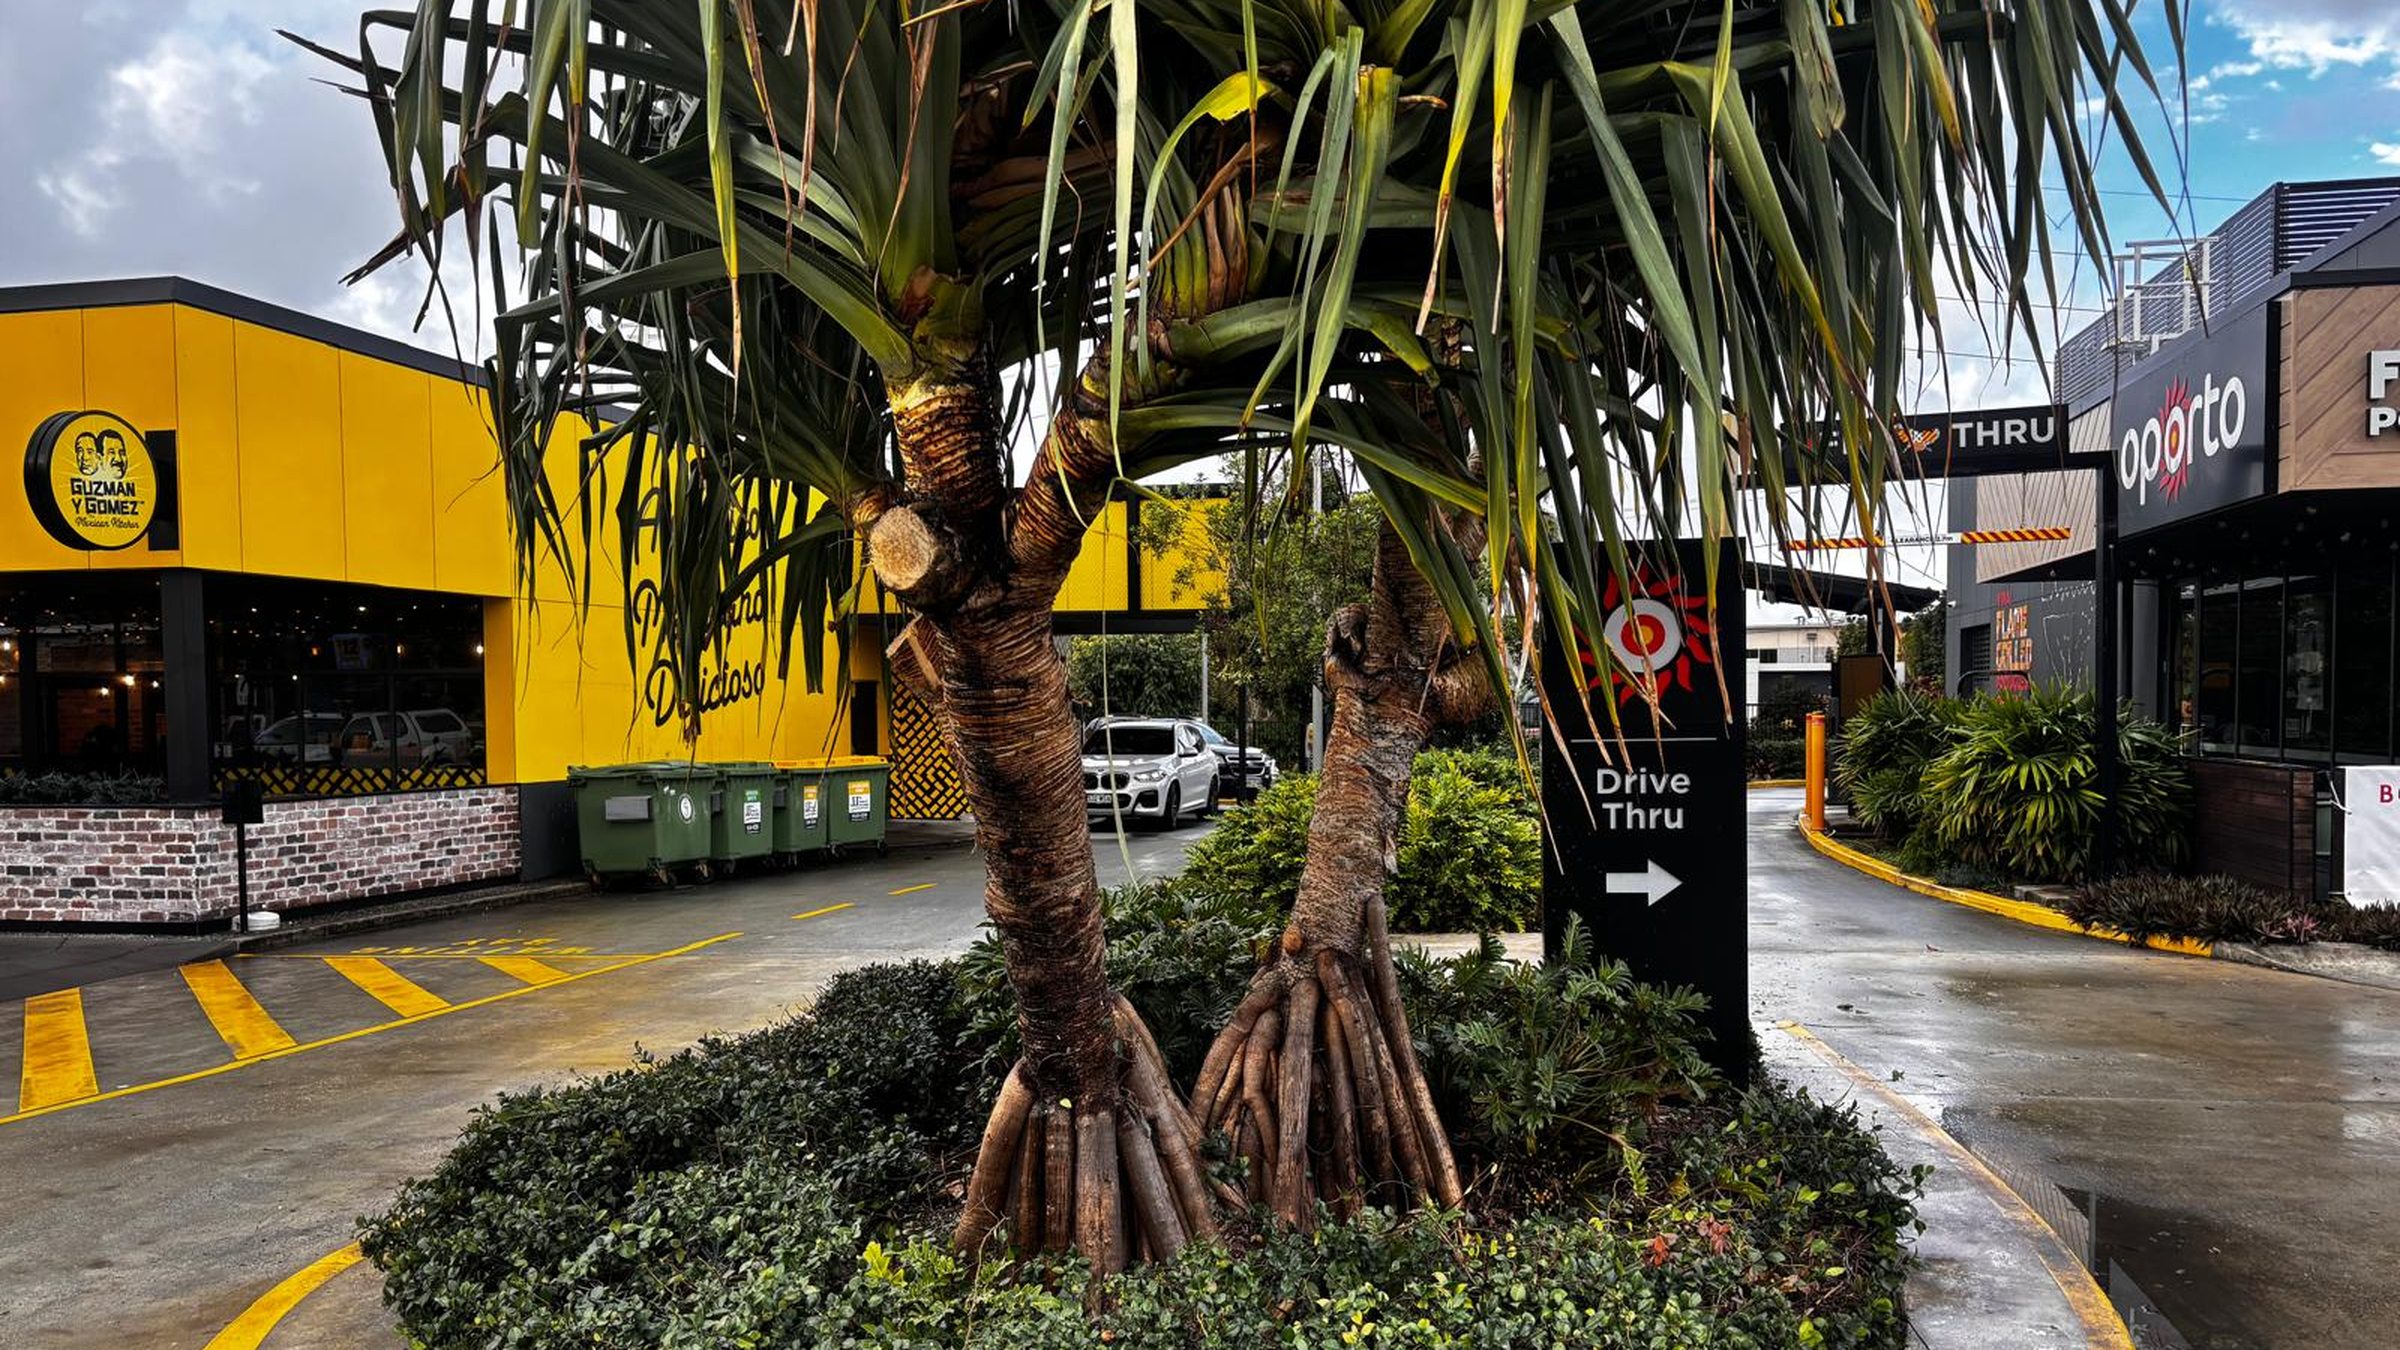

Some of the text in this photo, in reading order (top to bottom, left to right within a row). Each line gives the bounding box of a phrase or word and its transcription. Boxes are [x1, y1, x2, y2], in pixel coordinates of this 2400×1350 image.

[1951, 417, 2054, 448] THRU
[2369, 407, 2400, 436] P
[2121, 373, 2246, 505] oporto
[70, 478, 136, 496] GUZMAN
[71, 498, 140, 515] Y GOMEZ
[1597, 767, 1691, 794] Drive
[2379, 784, 2400, 803] B
[1602, 801, 1684, 829] Thru
